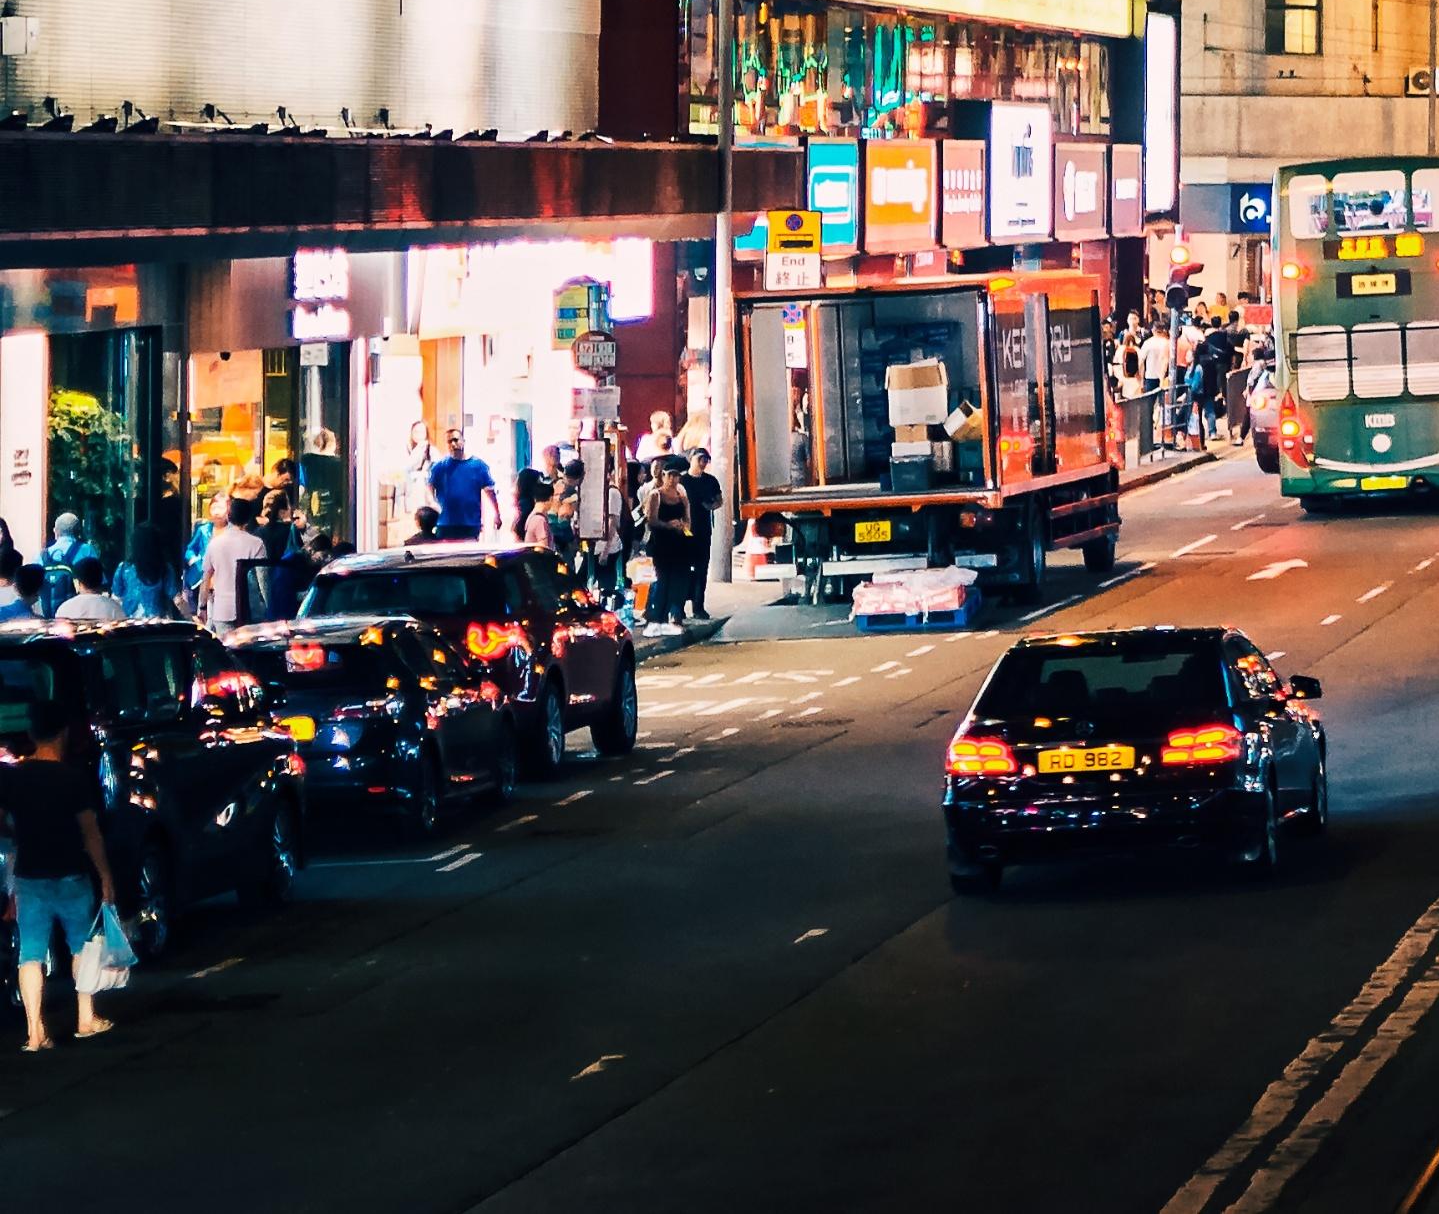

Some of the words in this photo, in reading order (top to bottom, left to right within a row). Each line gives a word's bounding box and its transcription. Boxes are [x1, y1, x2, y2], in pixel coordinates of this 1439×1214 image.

[781, 256, 806, 267] End
[1050, 753, 1075, 769] RD
[1085, 752, 1122, 767] 982
